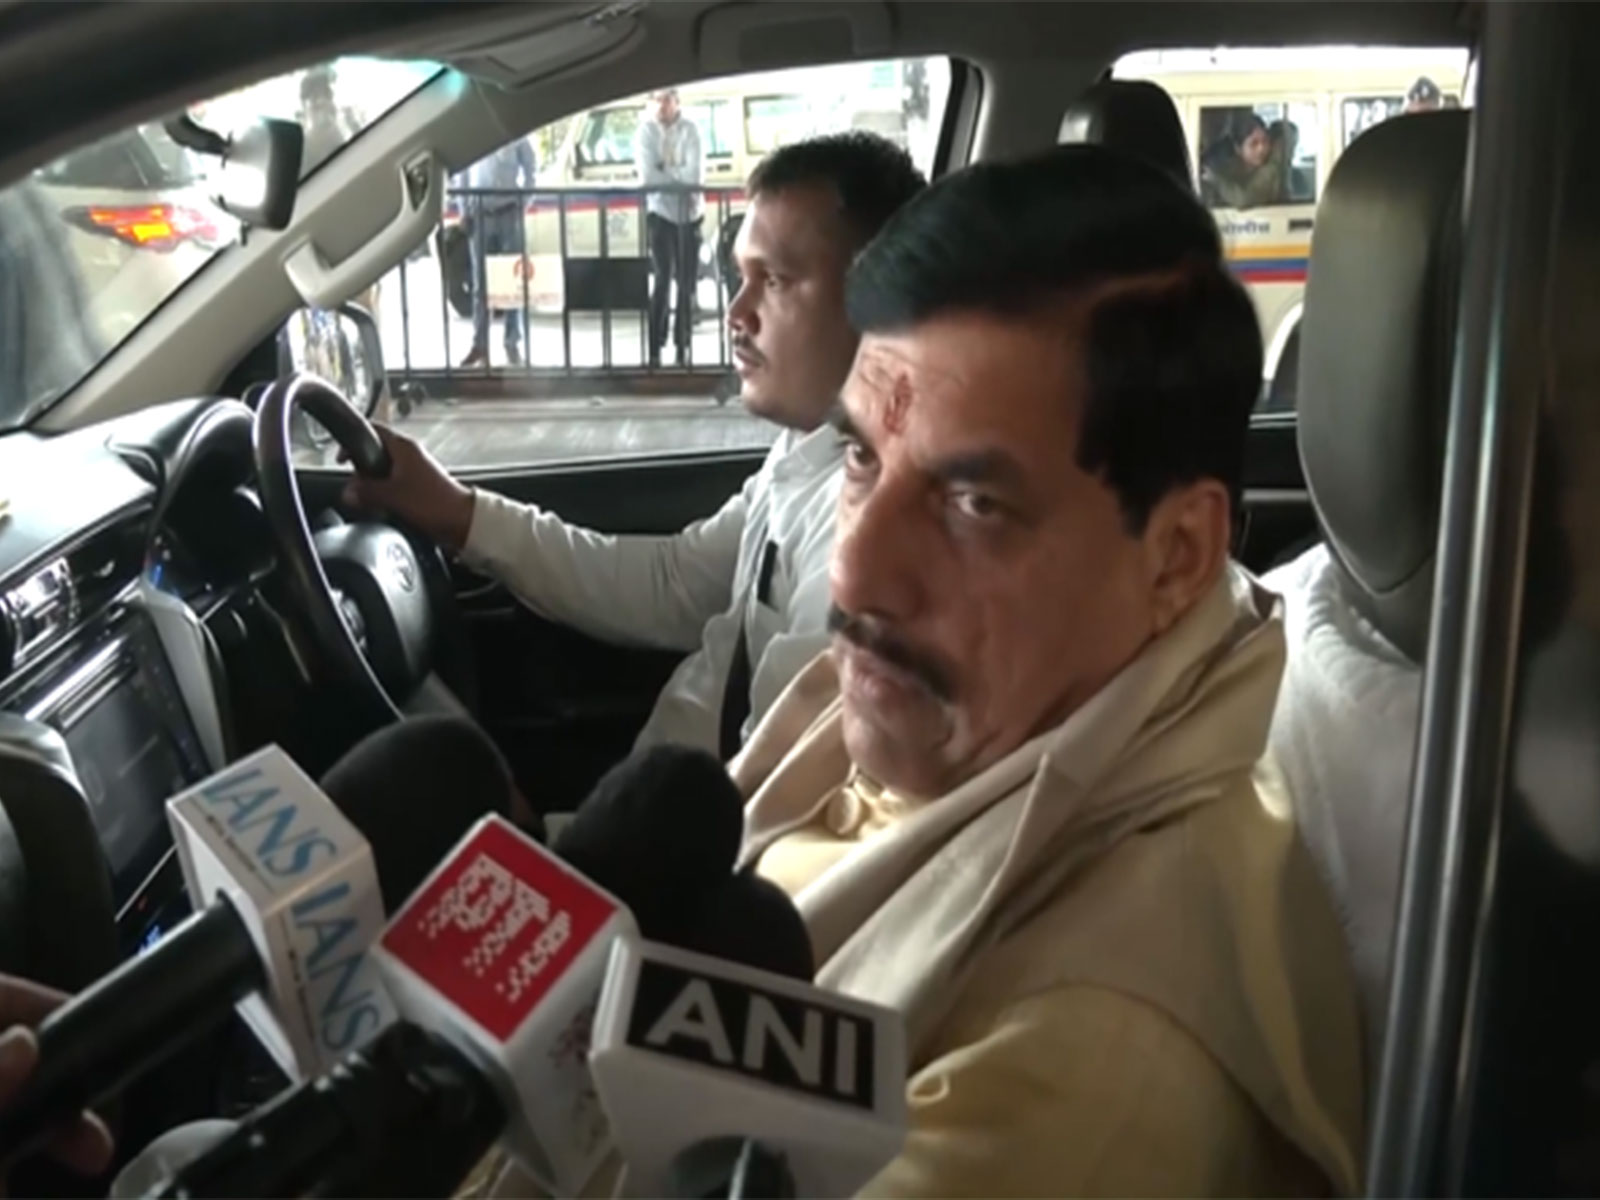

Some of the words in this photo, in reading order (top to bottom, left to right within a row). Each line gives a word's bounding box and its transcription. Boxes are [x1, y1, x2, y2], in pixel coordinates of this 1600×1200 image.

[201, 767, 336, 876] IANS
[291, 881, 380, 1052] IANS
[418, 853, 572, 1002] PTI
[644, 976, 858, 1098] ANI
